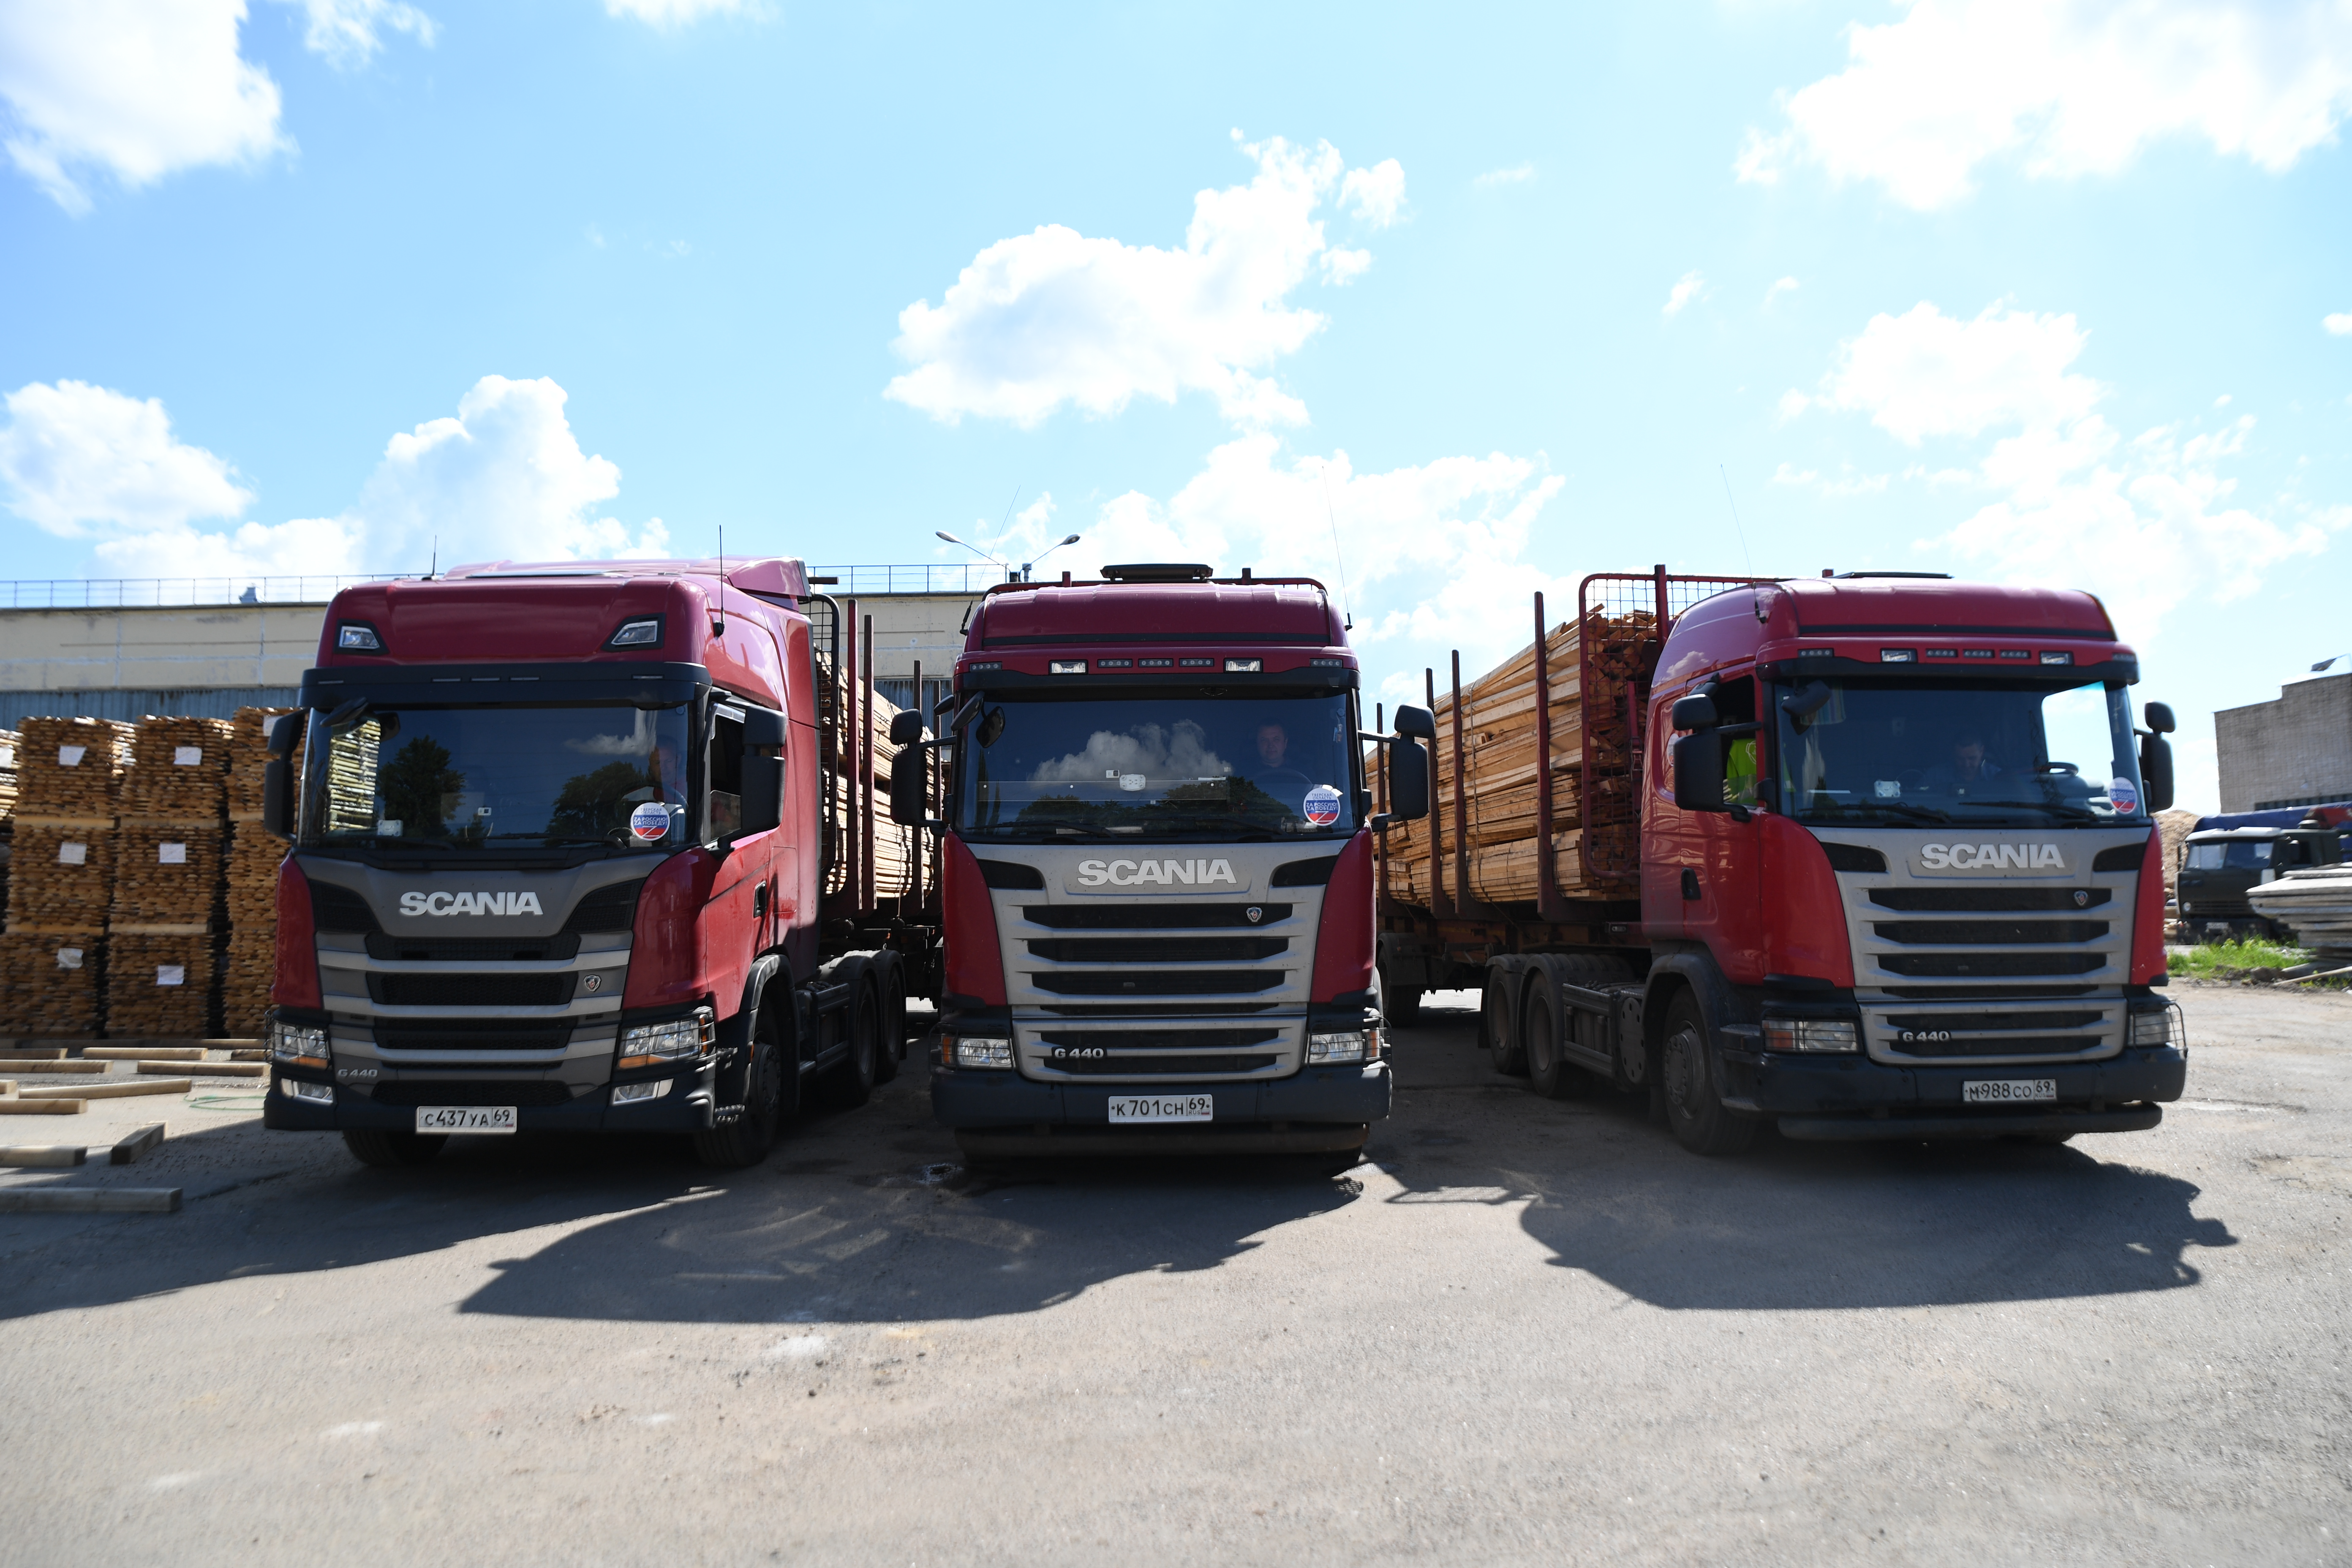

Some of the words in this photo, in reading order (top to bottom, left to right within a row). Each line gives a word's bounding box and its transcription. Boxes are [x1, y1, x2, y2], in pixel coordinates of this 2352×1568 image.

[1920, 843, 2065, 869] SCANIA
[1077, 859, 1238, 886] SCANIA
[400, 891, 544, 915] SCANIA
[1903, 1031, 1914, 1042] G
[1916, 1031, 1949, 1042] 440
[1055, 1048, 1066, 1058] G
[1069, 1048, 1104, 1058] 440
[338, 1069, 348, 1077] G
[349, 1069, 378, 1077] 440
[2036, 1081, 2050, 1093] 69
[1189, 1097, 1205, 1110] 69
[494, 1109, 510, 1122] 69
